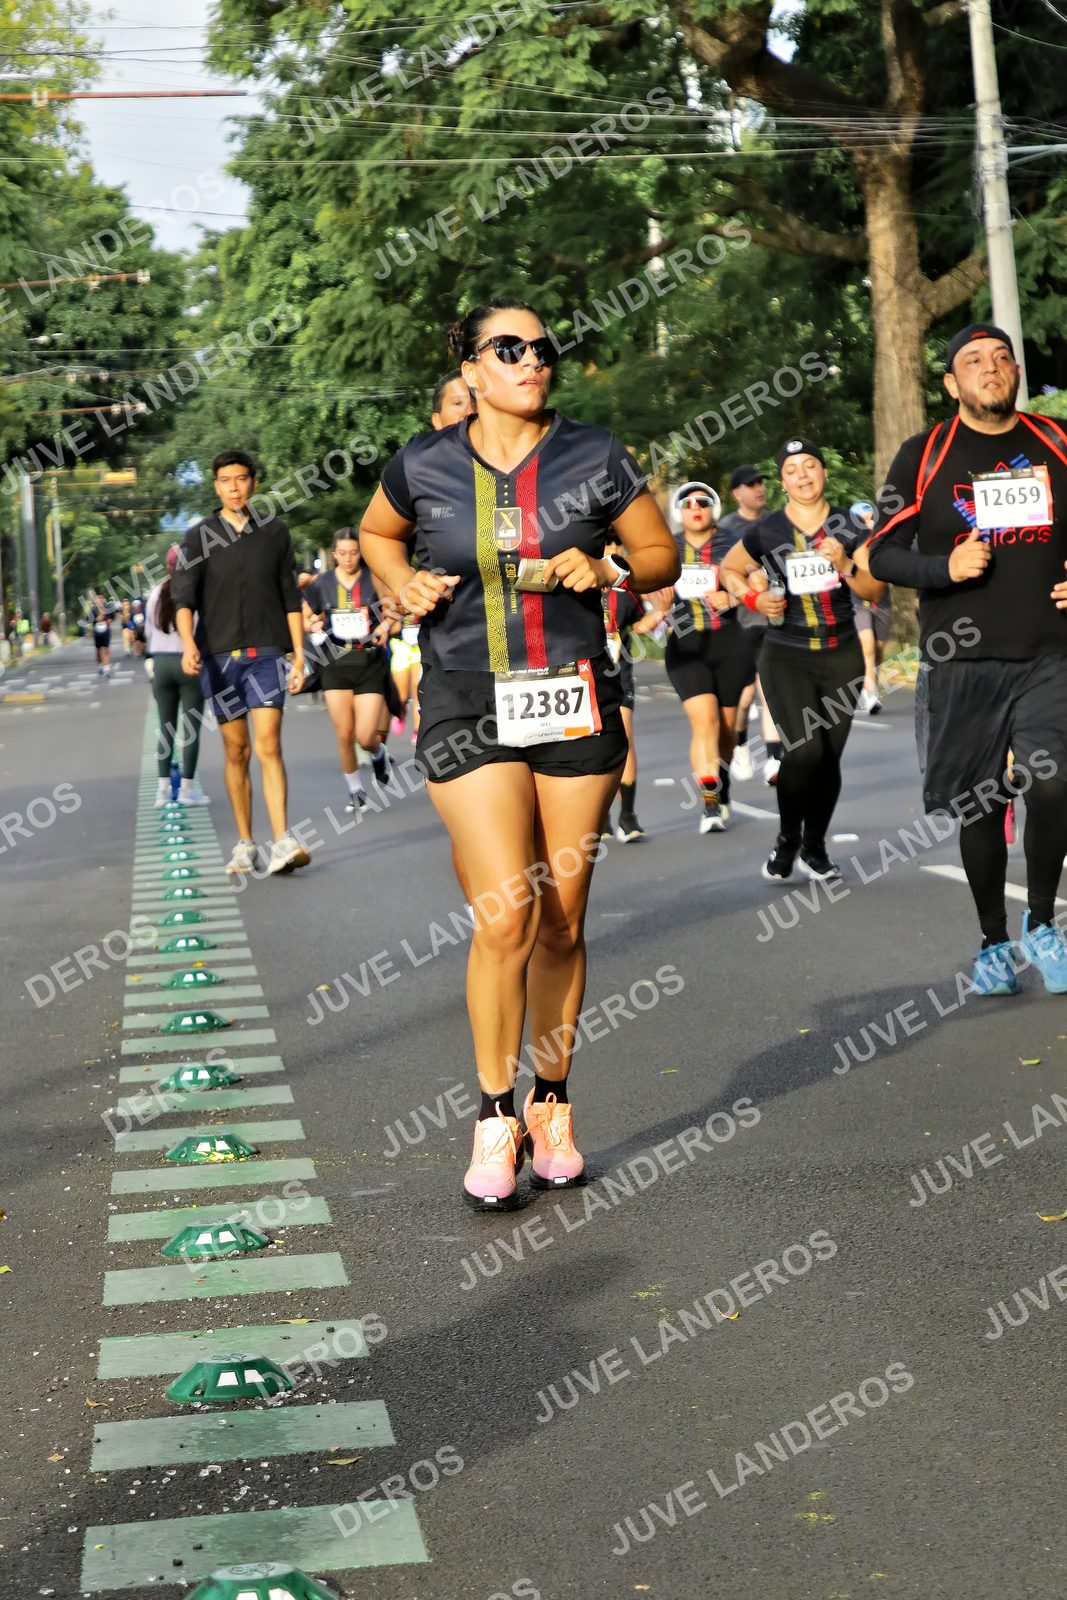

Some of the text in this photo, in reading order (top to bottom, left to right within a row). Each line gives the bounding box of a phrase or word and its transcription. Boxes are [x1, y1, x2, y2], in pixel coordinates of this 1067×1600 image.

[980, 486, 1041, 507] 12659
[791, 561, 834, 578] 12304
[501, 686, 584, 720] 12387
